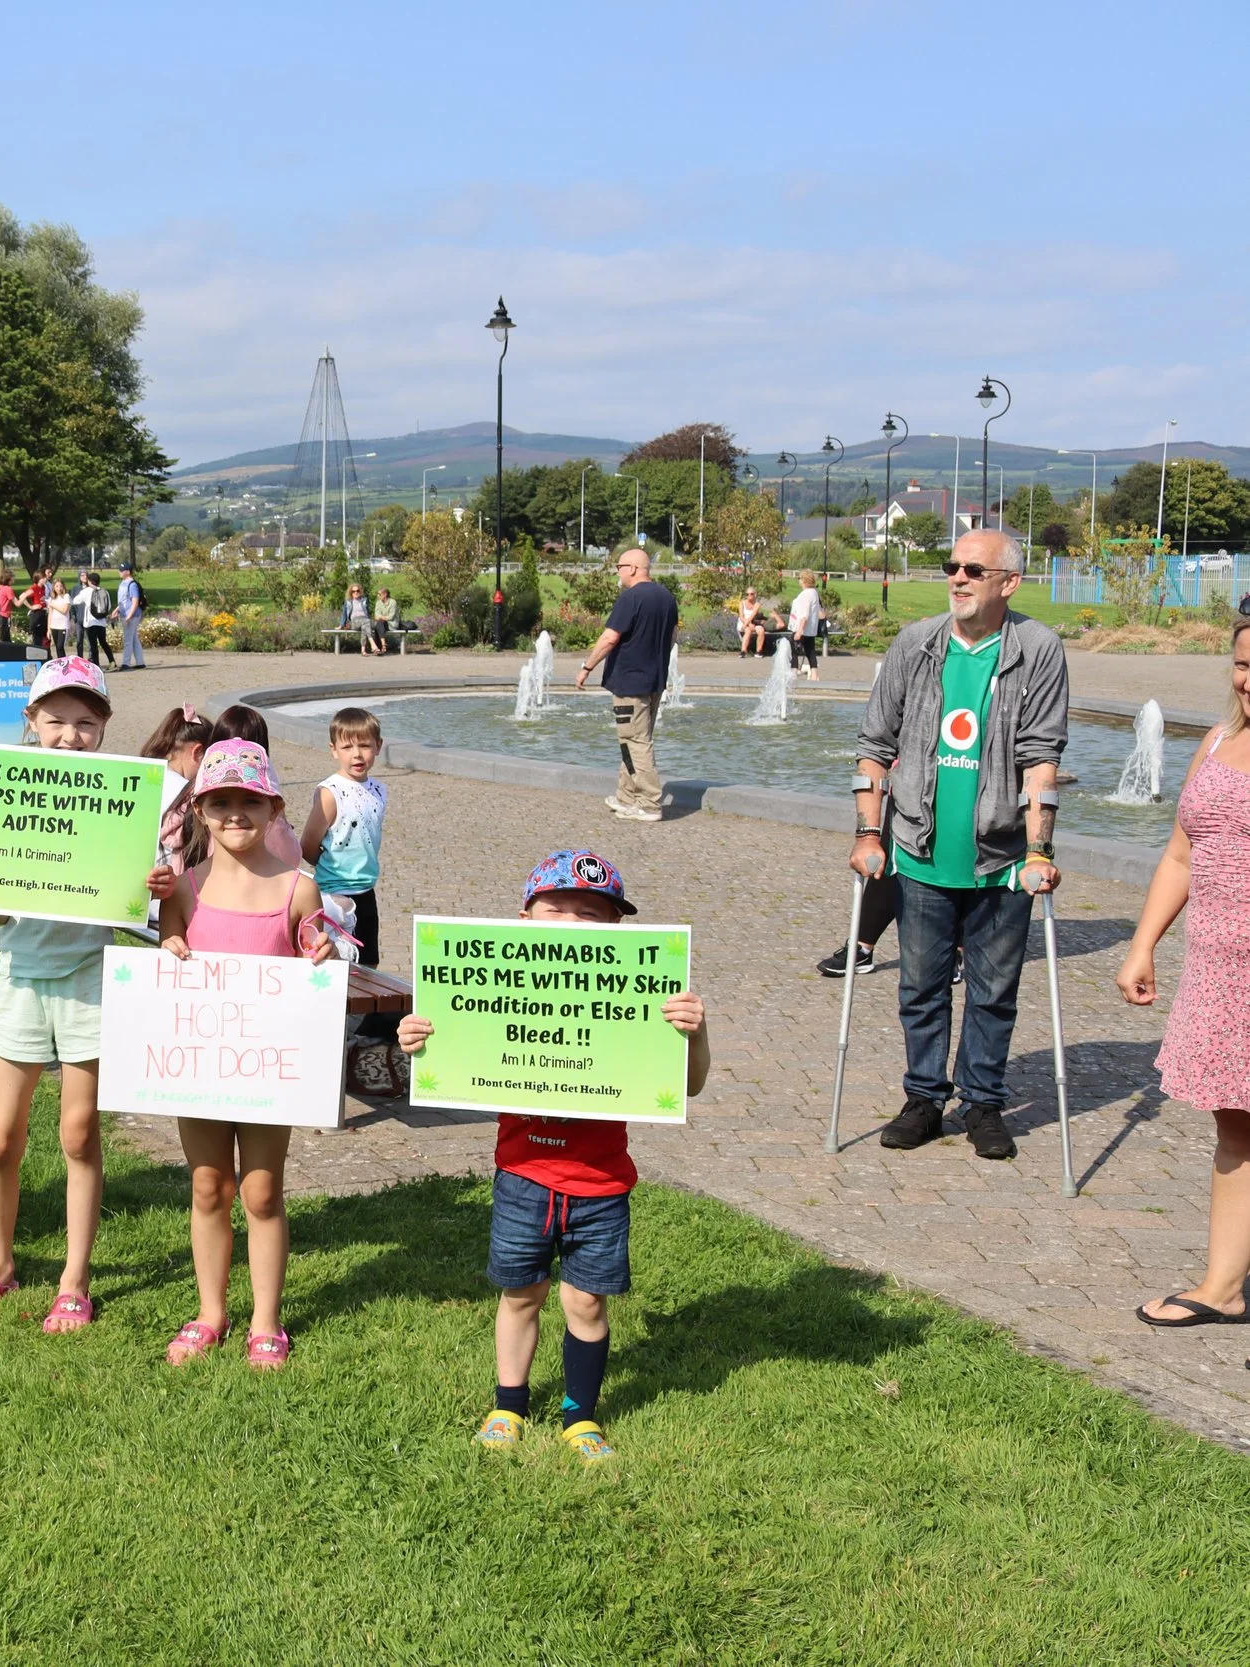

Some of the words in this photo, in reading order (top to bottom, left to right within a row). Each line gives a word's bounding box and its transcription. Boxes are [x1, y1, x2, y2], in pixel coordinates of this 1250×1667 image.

[8, 678, 23, 687] Pla
[8, 690, 31, 698] Trac
[937, 754, 979, 770] odafon
[7, 766, 107, 790] CANNABIS.
[122, 776, 141, 793] IT
[21, 791, 47, 808] ME
[53, 795, 100, 814] WITH
[2, 814, 78, 836] AUTISM.
[11, 847, 14, 858] I
[17, 847, 22, 858] A
[26, 848, 72, 863] Criminal?
[0, 878, 14, 887] Get
[15, 879, 40, 890] High,
[42, 882, 45, 890] I
[47, 882, 62, 892] Get
[64, 885, 99, 897] Healthy
[444, 940, 450, 956] I
[456, 940, 495, 960] USE
[502, 942, 622, 964] CANNABIS.
[638, 946, 660, 965] IT
[156, 957, 241, 991] HEMP
[258, 964, 282, 995] IS
[421, 965, 487, 986] HELPS
[494, 969, 525, 988] ME
[531, 971, 589, 992] WITH
[634, 975, 682, 995] Skin
[451, 994, 554, 1017] Condition
[560, 1003, 585, 1018] or
[591, 1000, 636, 1021] Else
[643, 1003, 649, 1021] I
[174, 1001, 261, 1039] HOPE
[506, 1024, 571, 1046] Bleed.
[146, 1045, 206, 1079] NOT
[218, 1046, 301, 1080] DOPE
[501, 1053, 519, 1066] Am
[522, 1054, 526, 1066] I
[529, 1055, 535, 1067] A
[539, 1056, 593, 1071] Criminal?
[471, 1077, 475, 1086] I
[477, 1077, 503, 1088] Dont
[505, 1079, 522, 1090] Get
[524, 1081, 553, 1093] High,
[554, 1083, 558, 1092] I
[560, 1083, 578, 1094] Get
[580, 1084, 622, 1097] Healthy
[528, 1134, 566, 1147] TENERIFE
